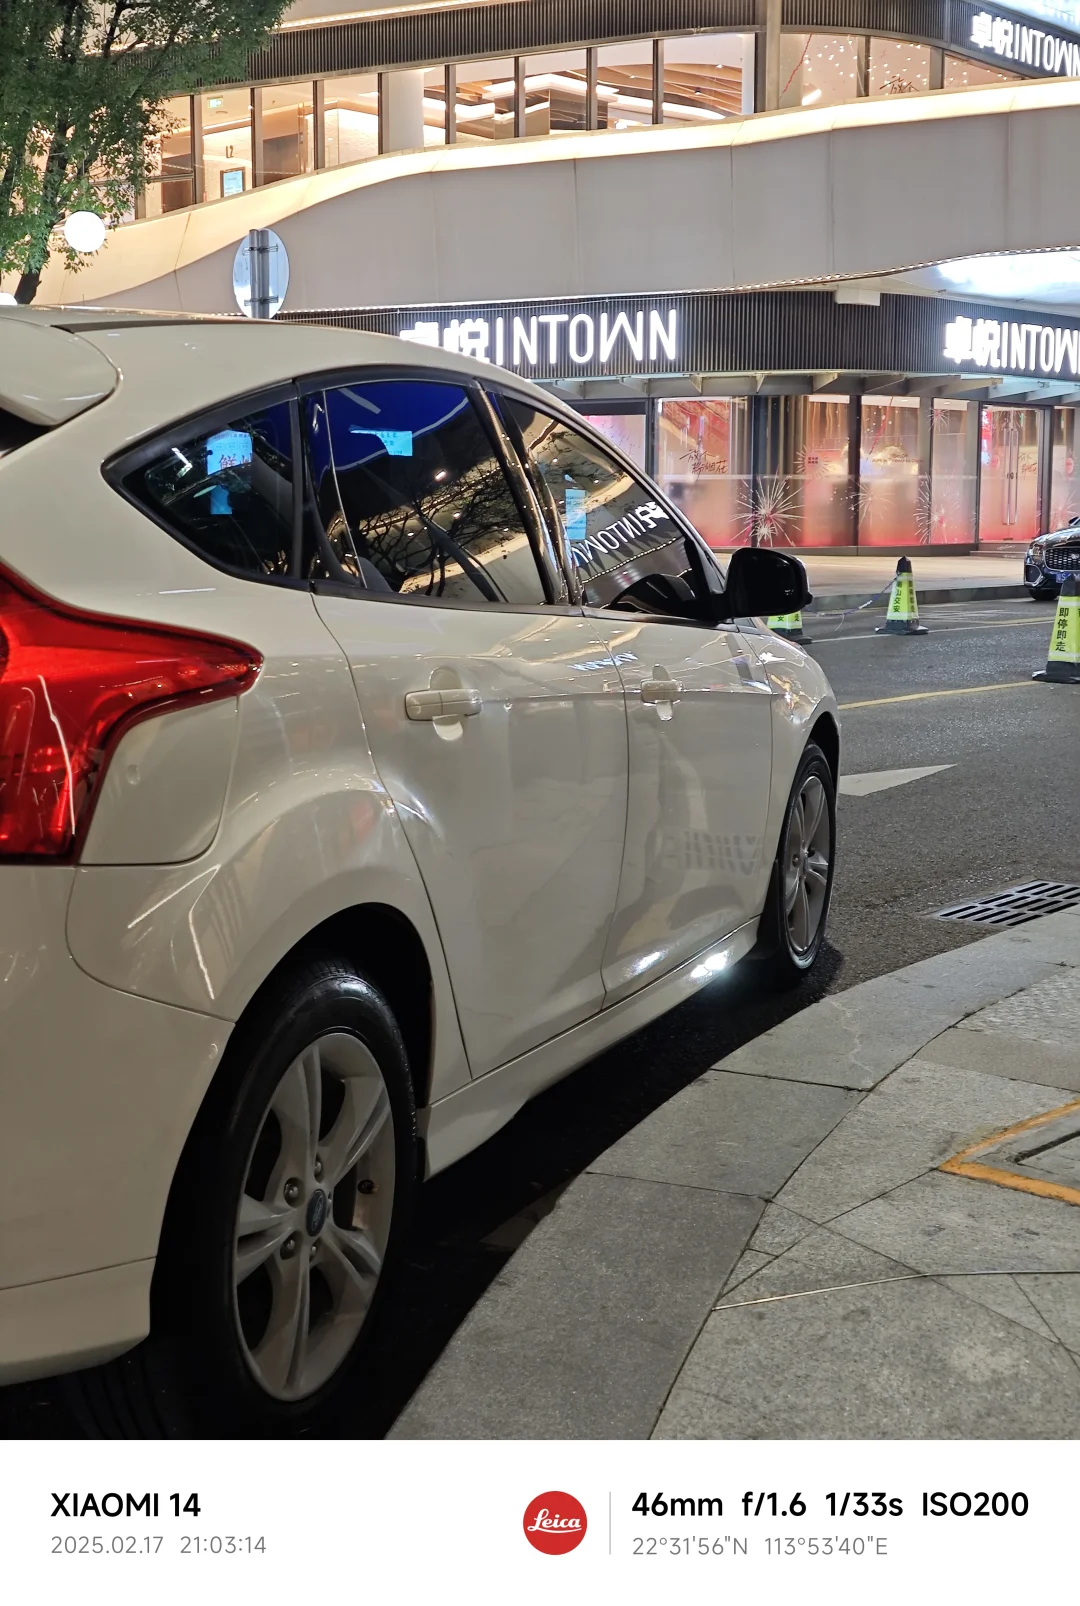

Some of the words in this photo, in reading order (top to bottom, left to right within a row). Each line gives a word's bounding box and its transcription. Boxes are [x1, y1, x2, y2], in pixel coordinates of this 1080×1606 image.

[496, 309, 677, 365] INTOWN
[1001, 321, 1080, 374] INTOW
[1055, 607, 1069, 652] 即停即走
